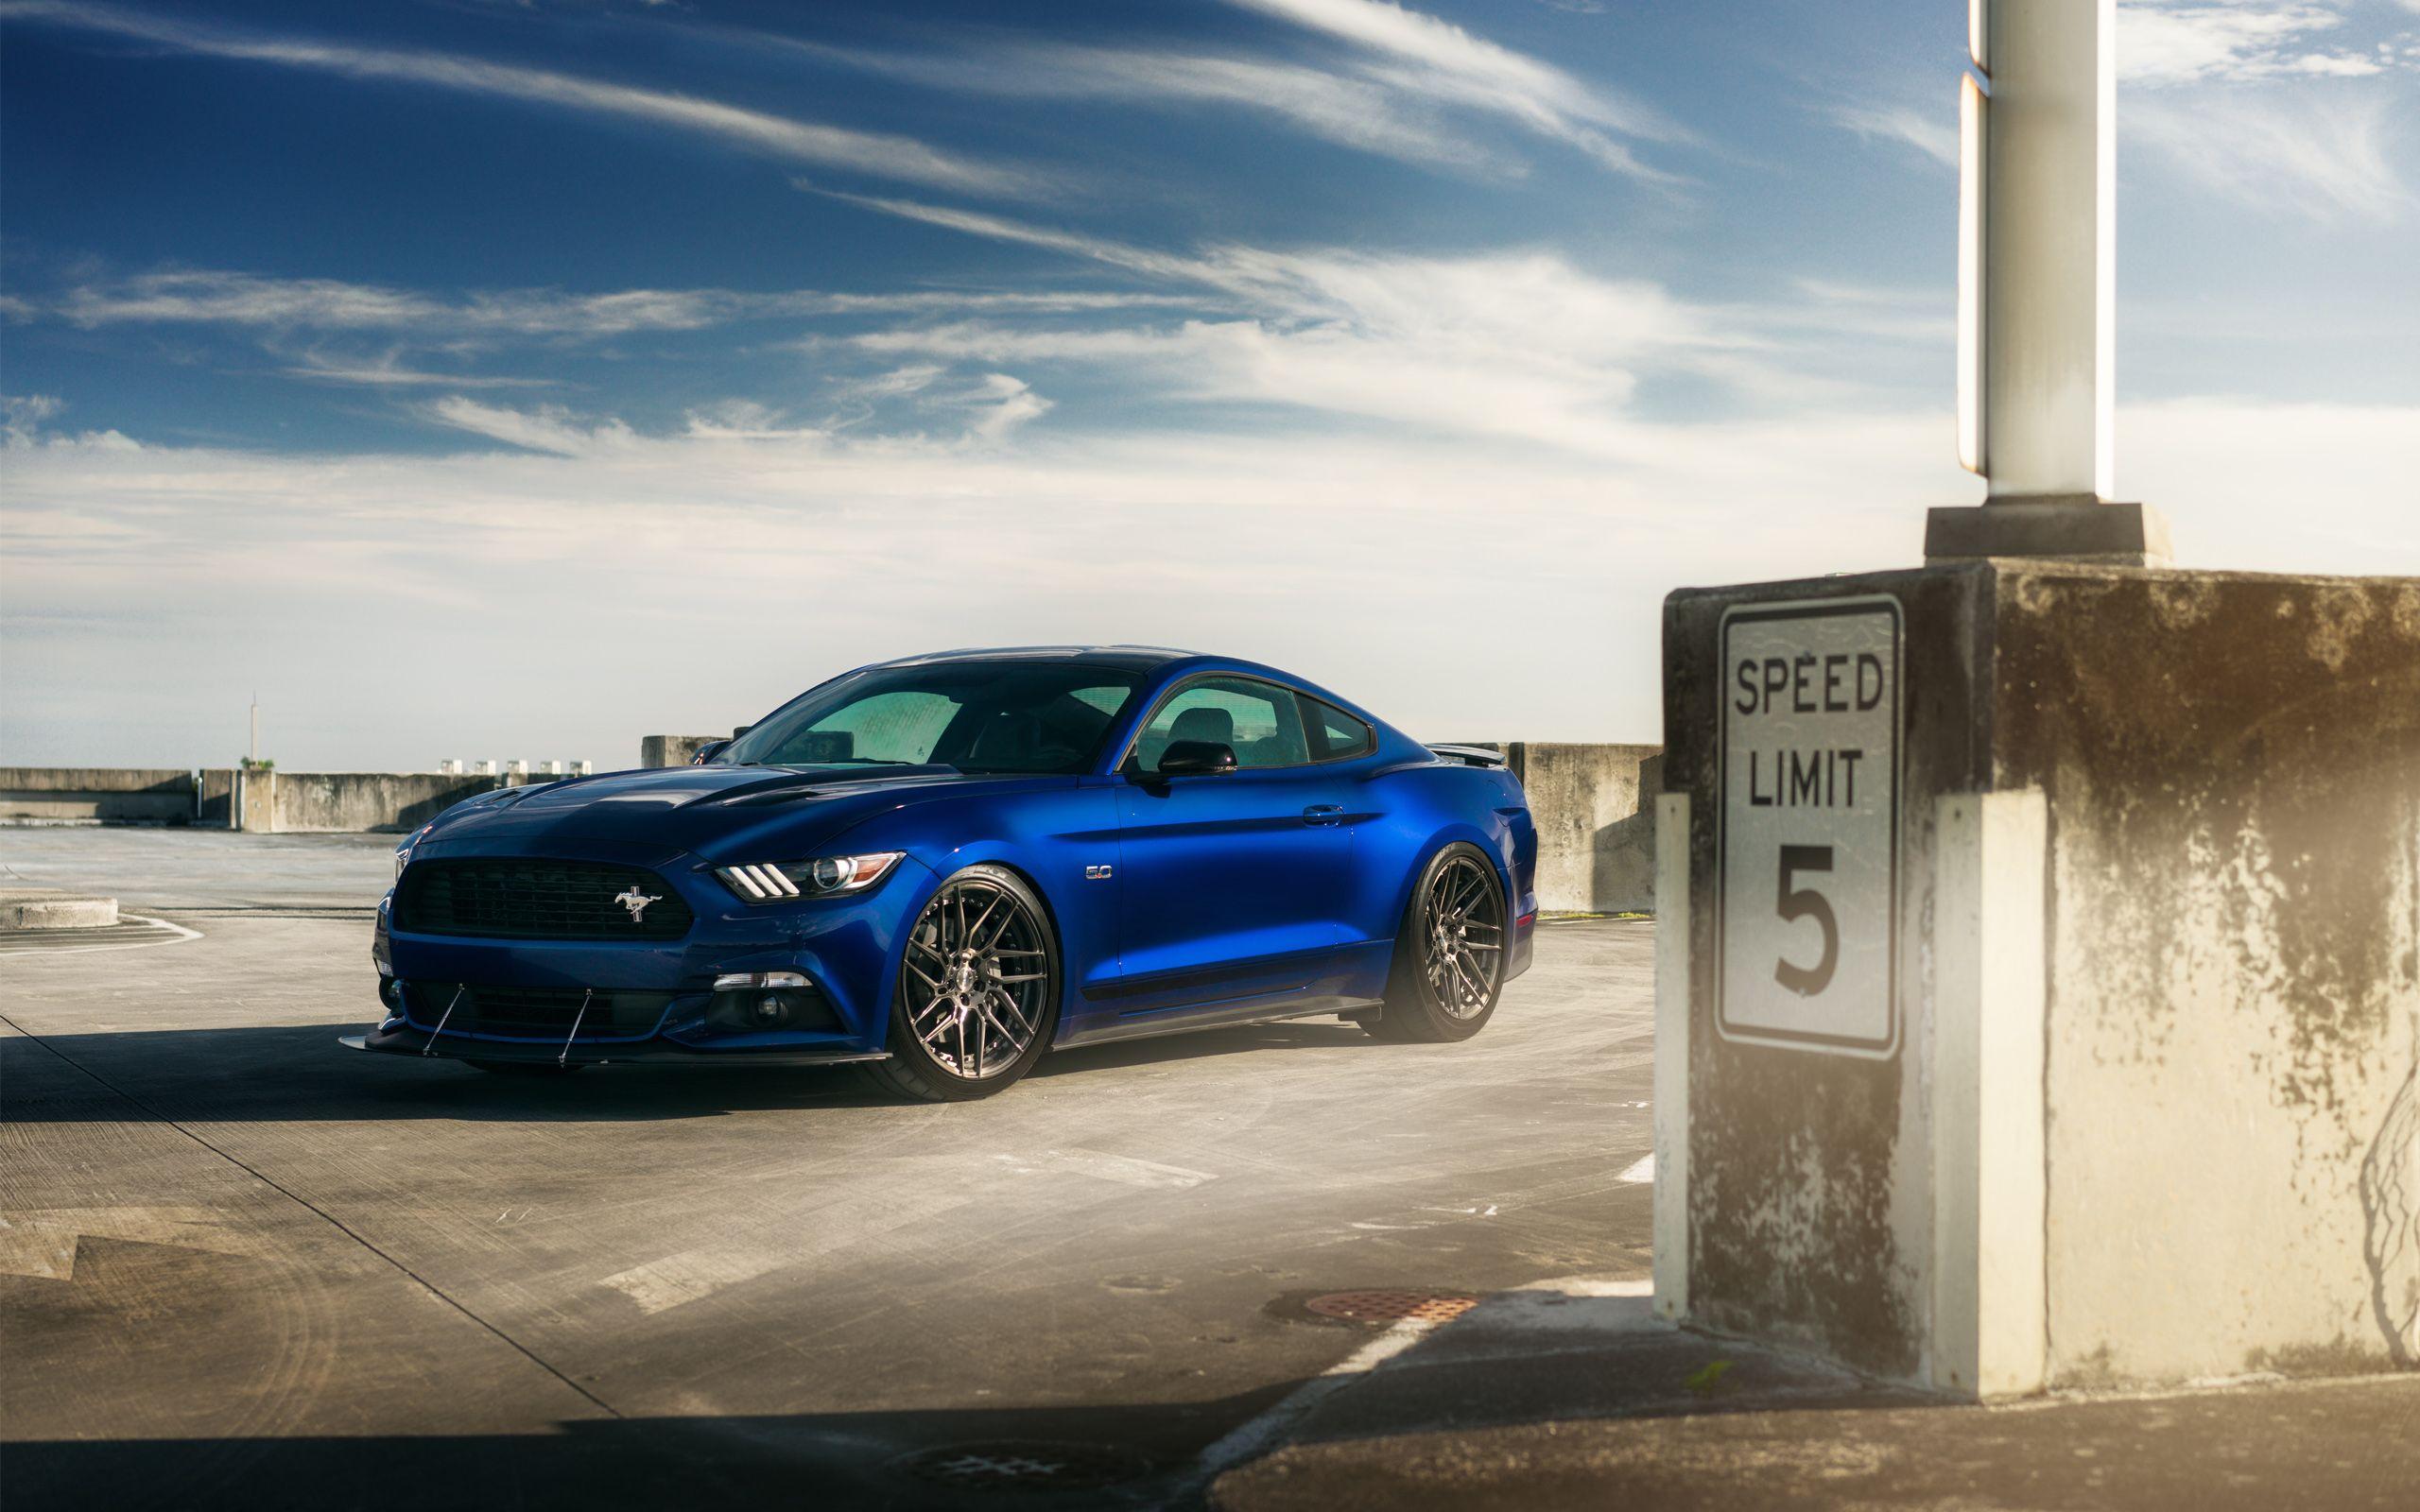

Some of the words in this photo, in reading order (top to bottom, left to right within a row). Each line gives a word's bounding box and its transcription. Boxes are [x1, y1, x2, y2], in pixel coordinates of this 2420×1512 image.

[1736, 653, 1883, 715] SPEED
[1750, 750, 1862, 807] LIMIT
[1774, 844, 1839, 997] 5
